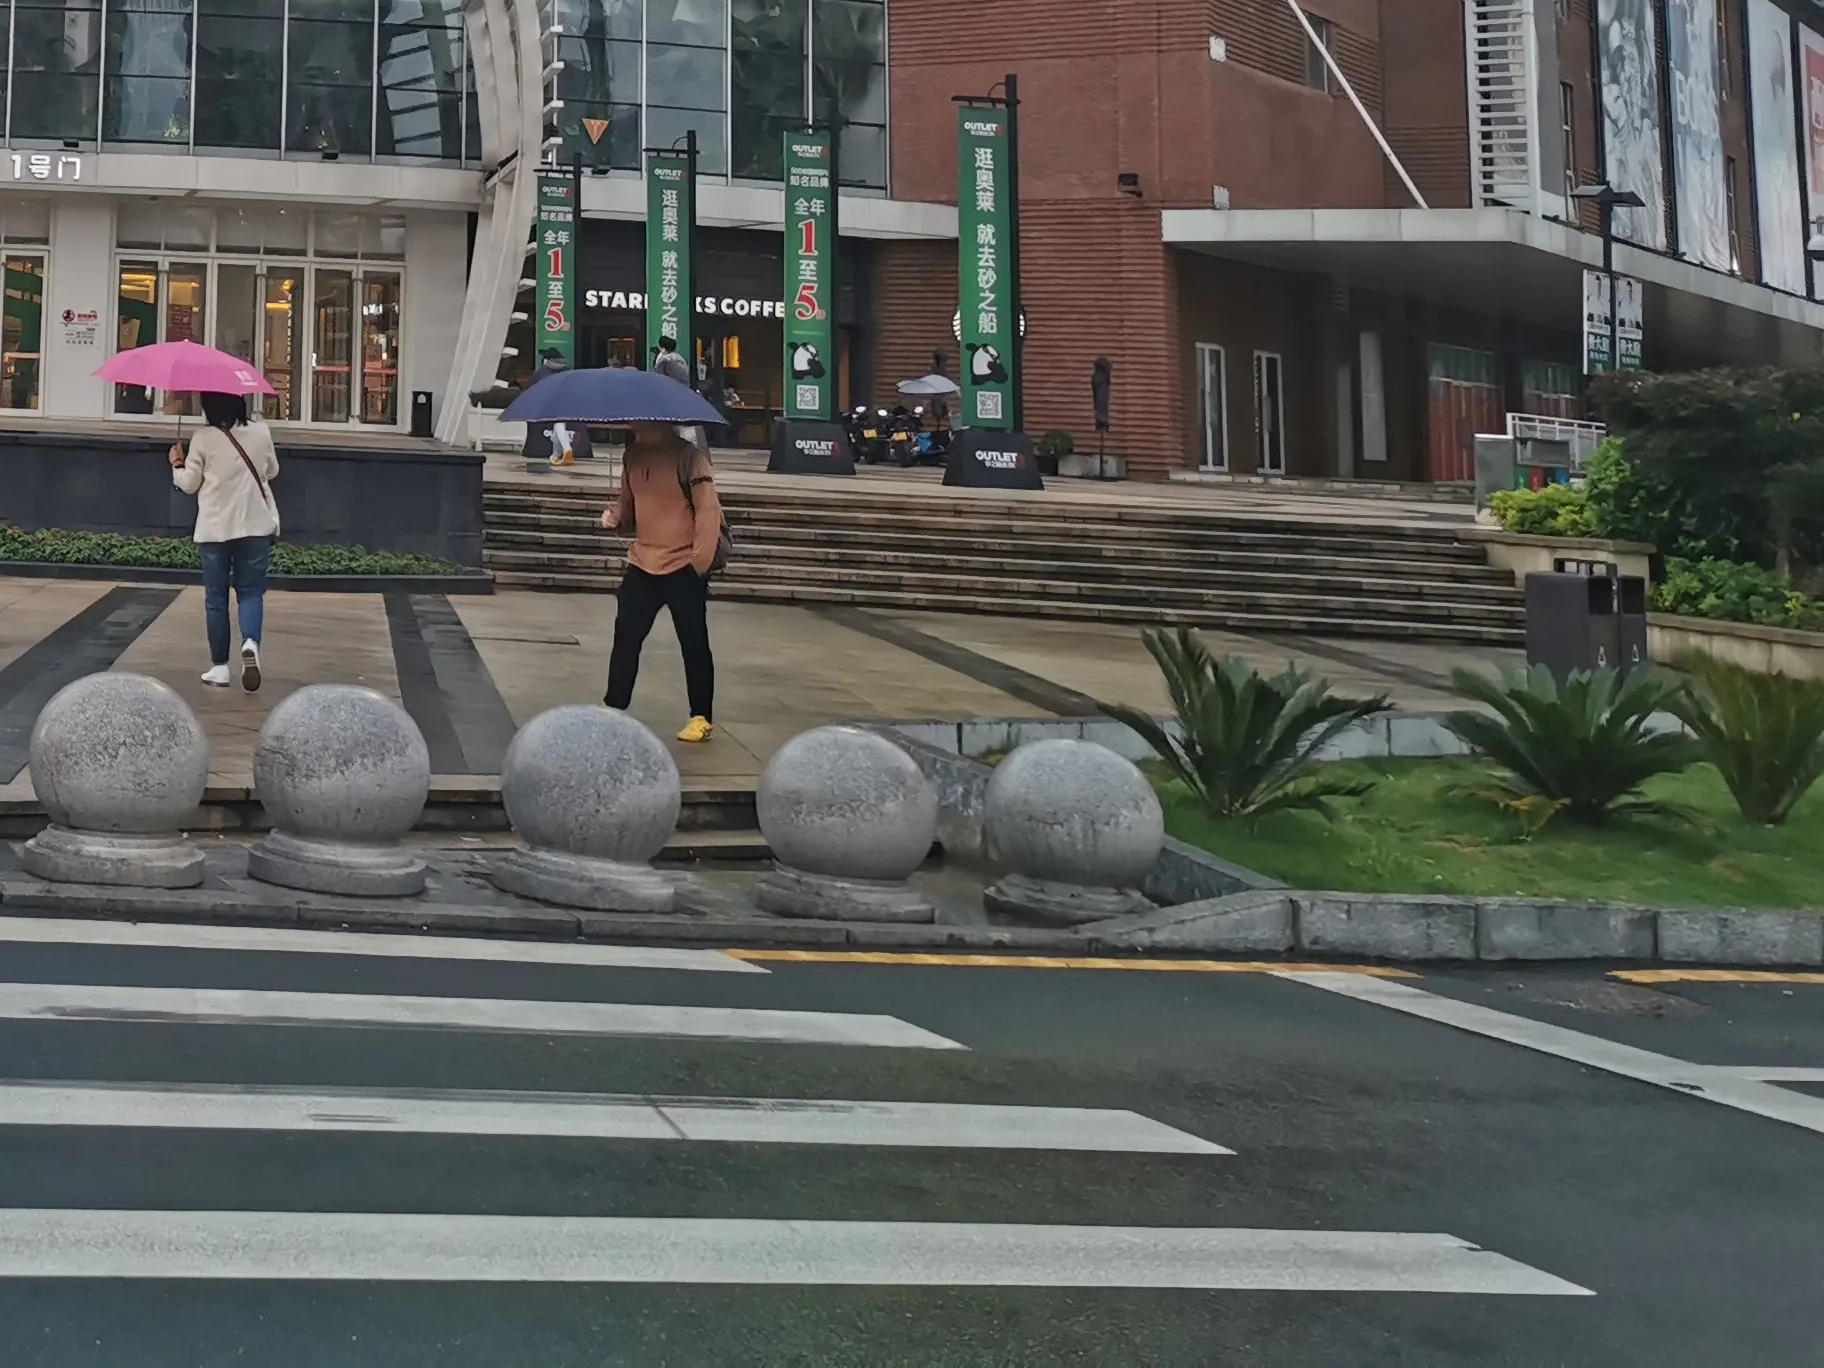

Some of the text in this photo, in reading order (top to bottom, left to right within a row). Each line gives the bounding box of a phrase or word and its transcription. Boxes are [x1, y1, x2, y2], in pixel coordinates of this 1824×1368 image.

[11, 153, 81, 180] 1号门
[975, 147, 995, 212] 逛奥莱
[794, 197, 826, 216] 全年
[544, 230, 570, 245] 全年
[977, 224, 997, 334] 就去砂之船
[720, 297, 785, 317] COFFE
